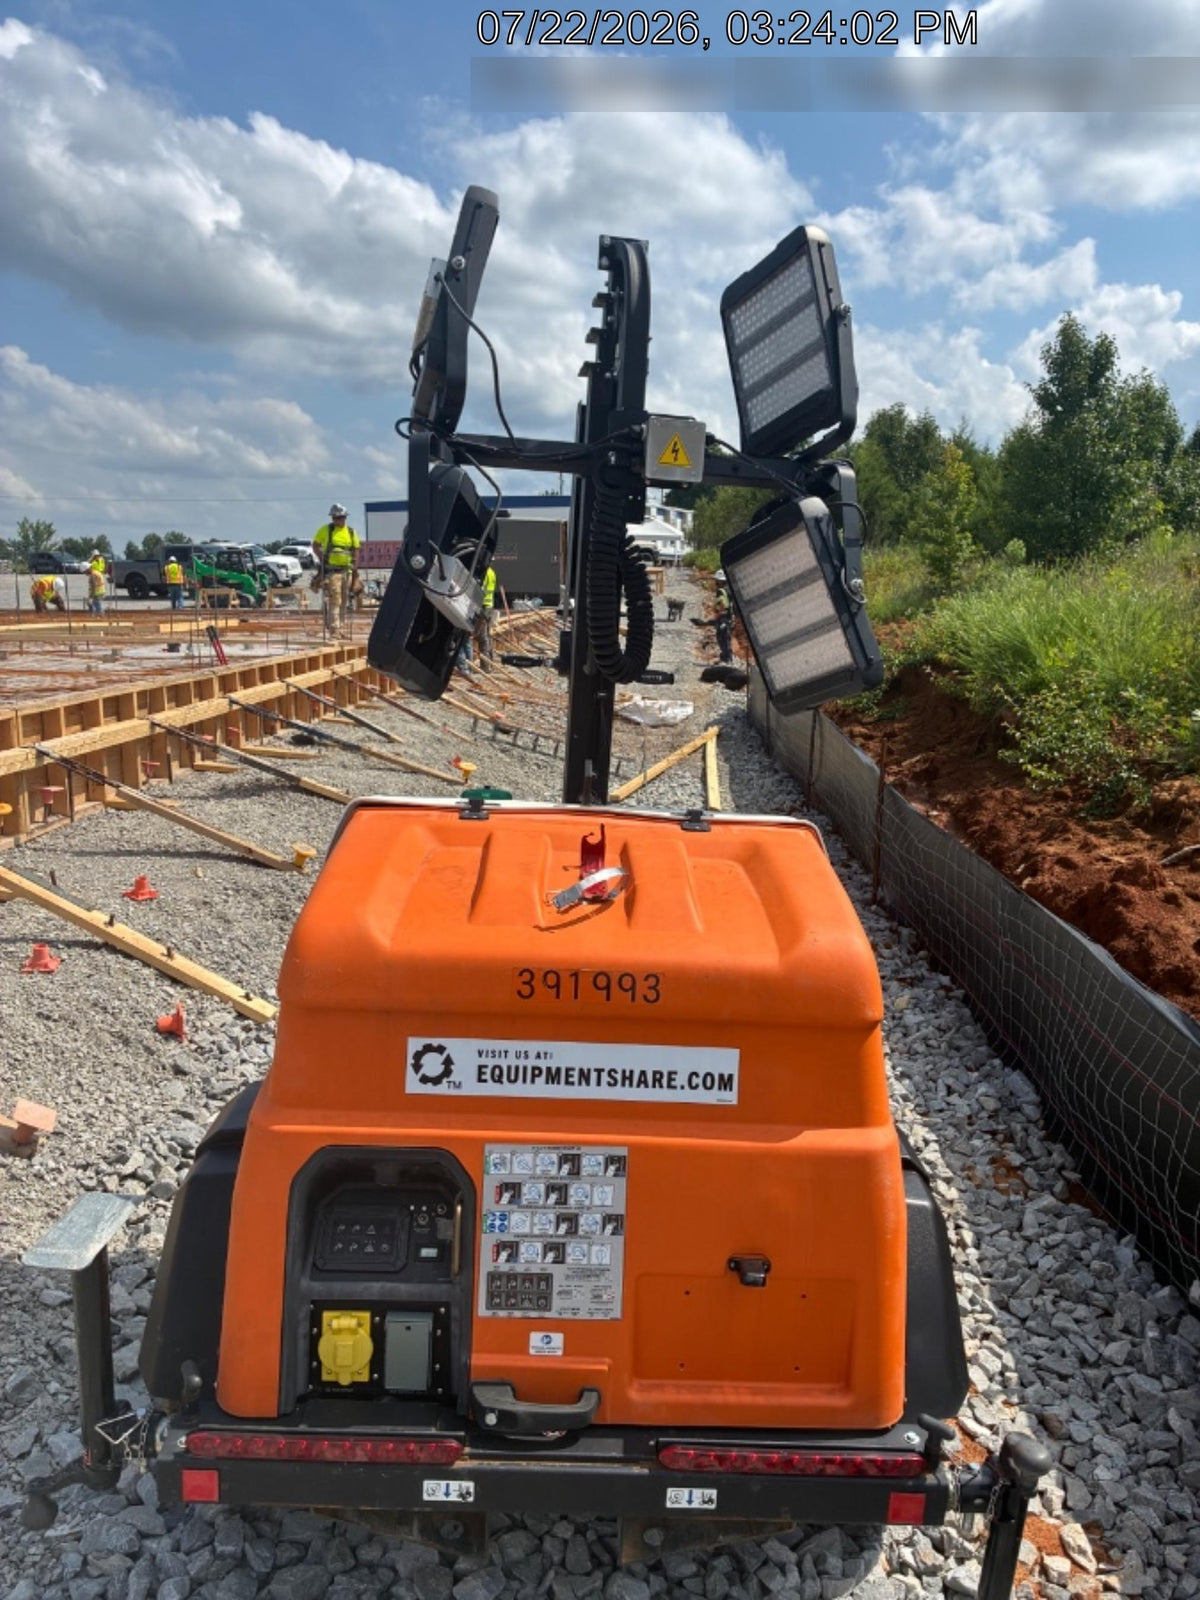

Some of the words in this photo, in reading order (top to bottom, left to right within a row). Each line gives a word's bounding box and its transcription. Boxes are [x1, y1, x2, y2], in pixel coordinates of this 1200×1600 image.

[515, 968, 662, 1004] 391993
[477, 1048, 509, 1060] VISIT
[515, 1049, 529, 1060] US
[476, 1063, 735, 1093] EQUIPMENTSHARE.COM
